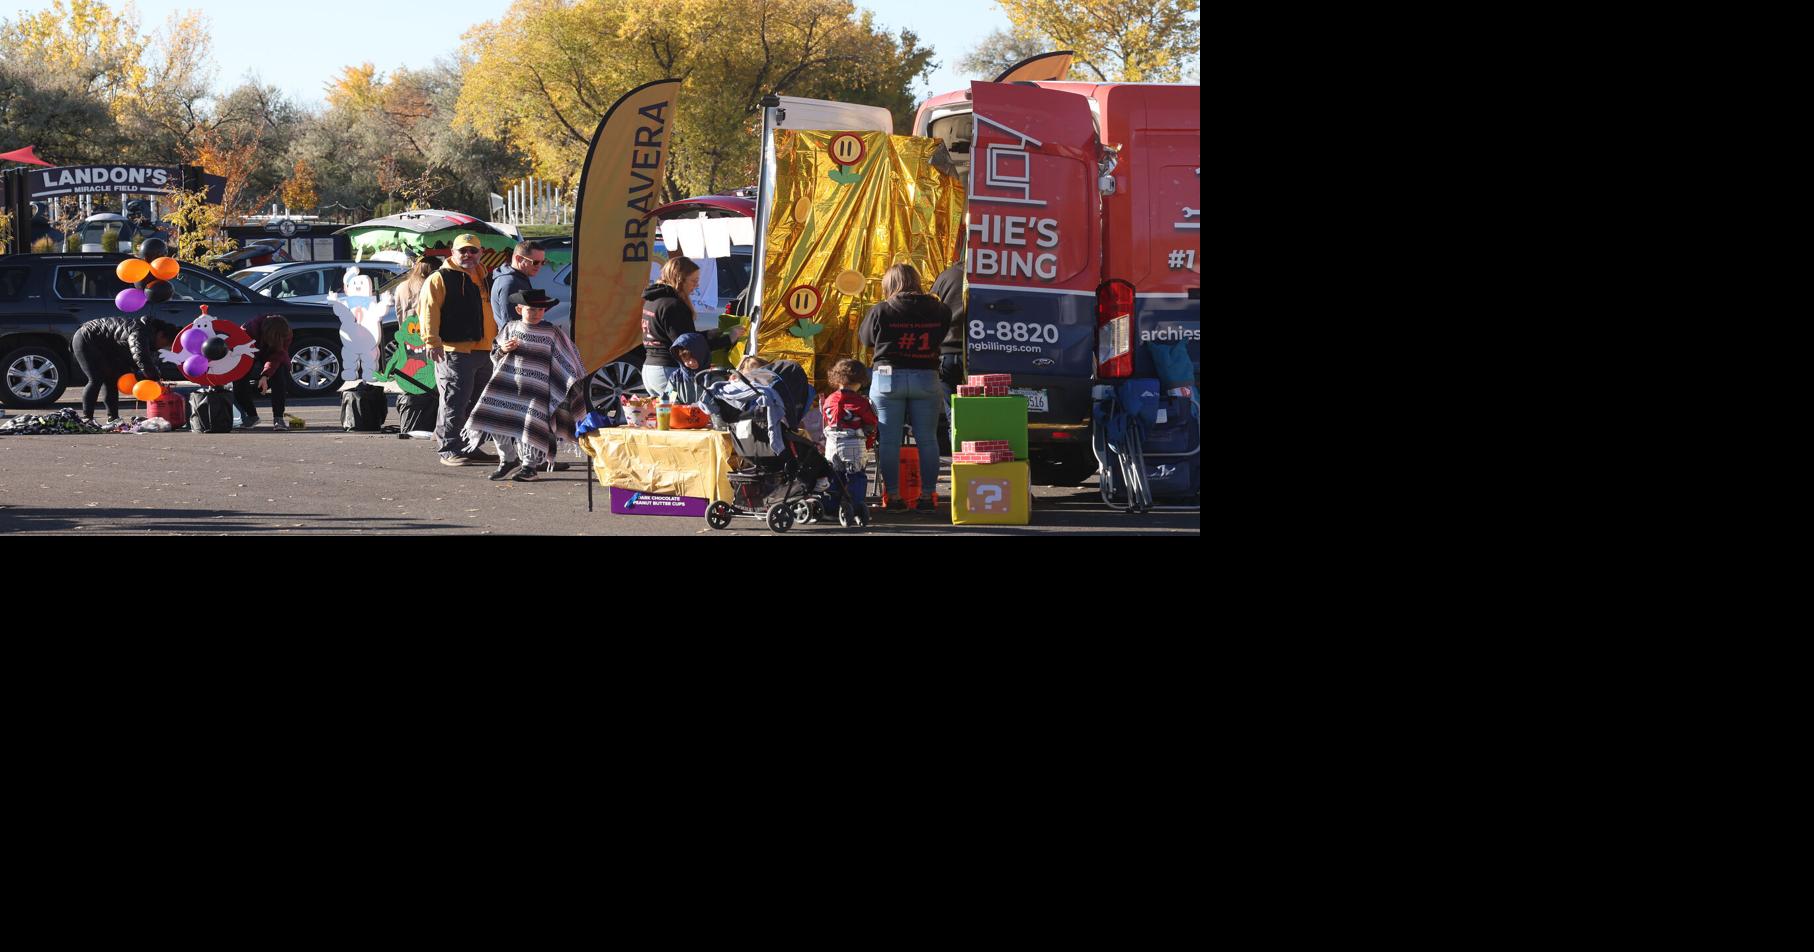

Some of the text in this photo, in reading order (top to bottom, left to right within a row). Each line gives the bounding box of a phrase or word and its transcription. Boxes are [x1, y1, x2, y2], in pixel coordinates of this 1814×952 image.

[43, 167, 167, 188] LANDON'S
[623, 101, 668, 263] BRAVERA
[74, 185, 111, 193] MIRACLE
[1168, 249, 1195, 269] #1
[897, 332, 930, 350] #1
[969, 319, 1059, 344] 8-8820
